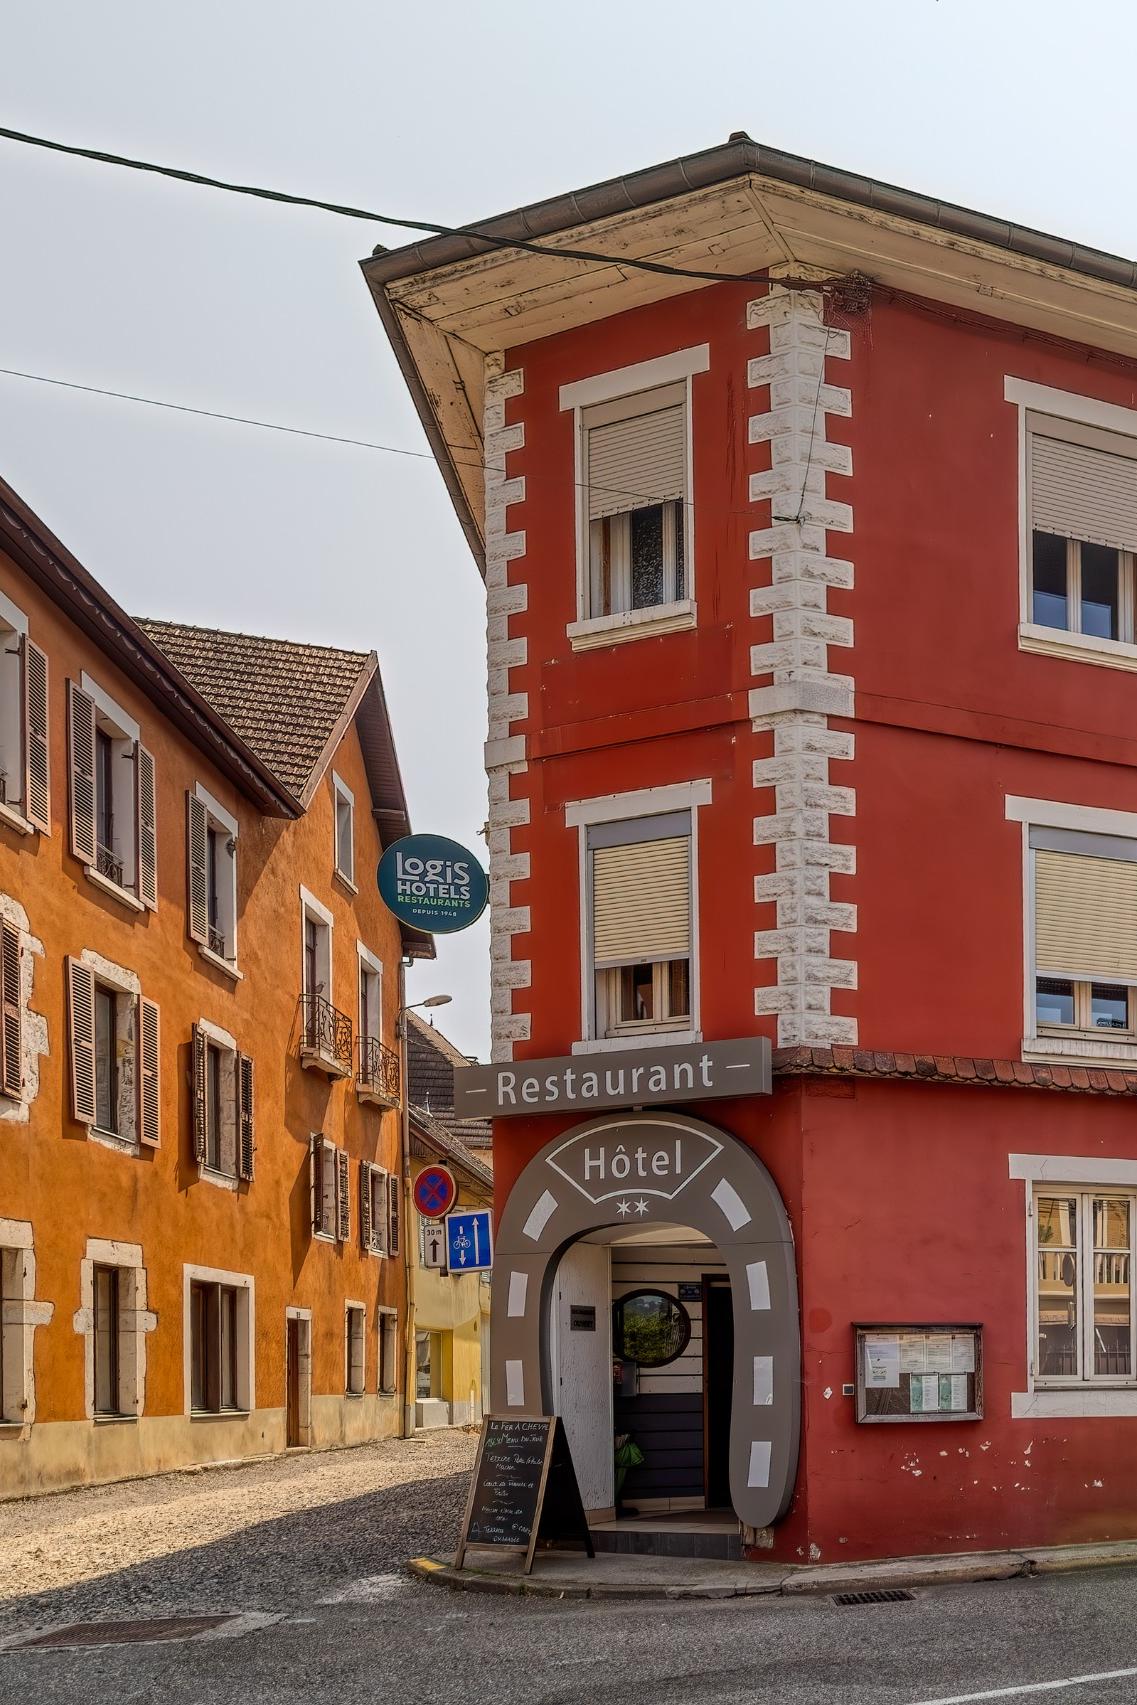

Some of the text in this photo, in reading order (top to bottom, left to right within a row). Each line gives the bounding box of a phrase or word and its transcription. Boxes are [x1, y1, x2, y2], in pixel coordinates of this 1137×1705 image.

[397, 881, 471, 900] HOTELS
[397, 895, 471, 908] RESTAURANTS
[412, 908, 439, 916] DEPUIS
[497, 1054, 714, 1106] Restaurant
[583, 1139, 682, 1181] Hôtel
[426, 1229, 436, 1237] 30
